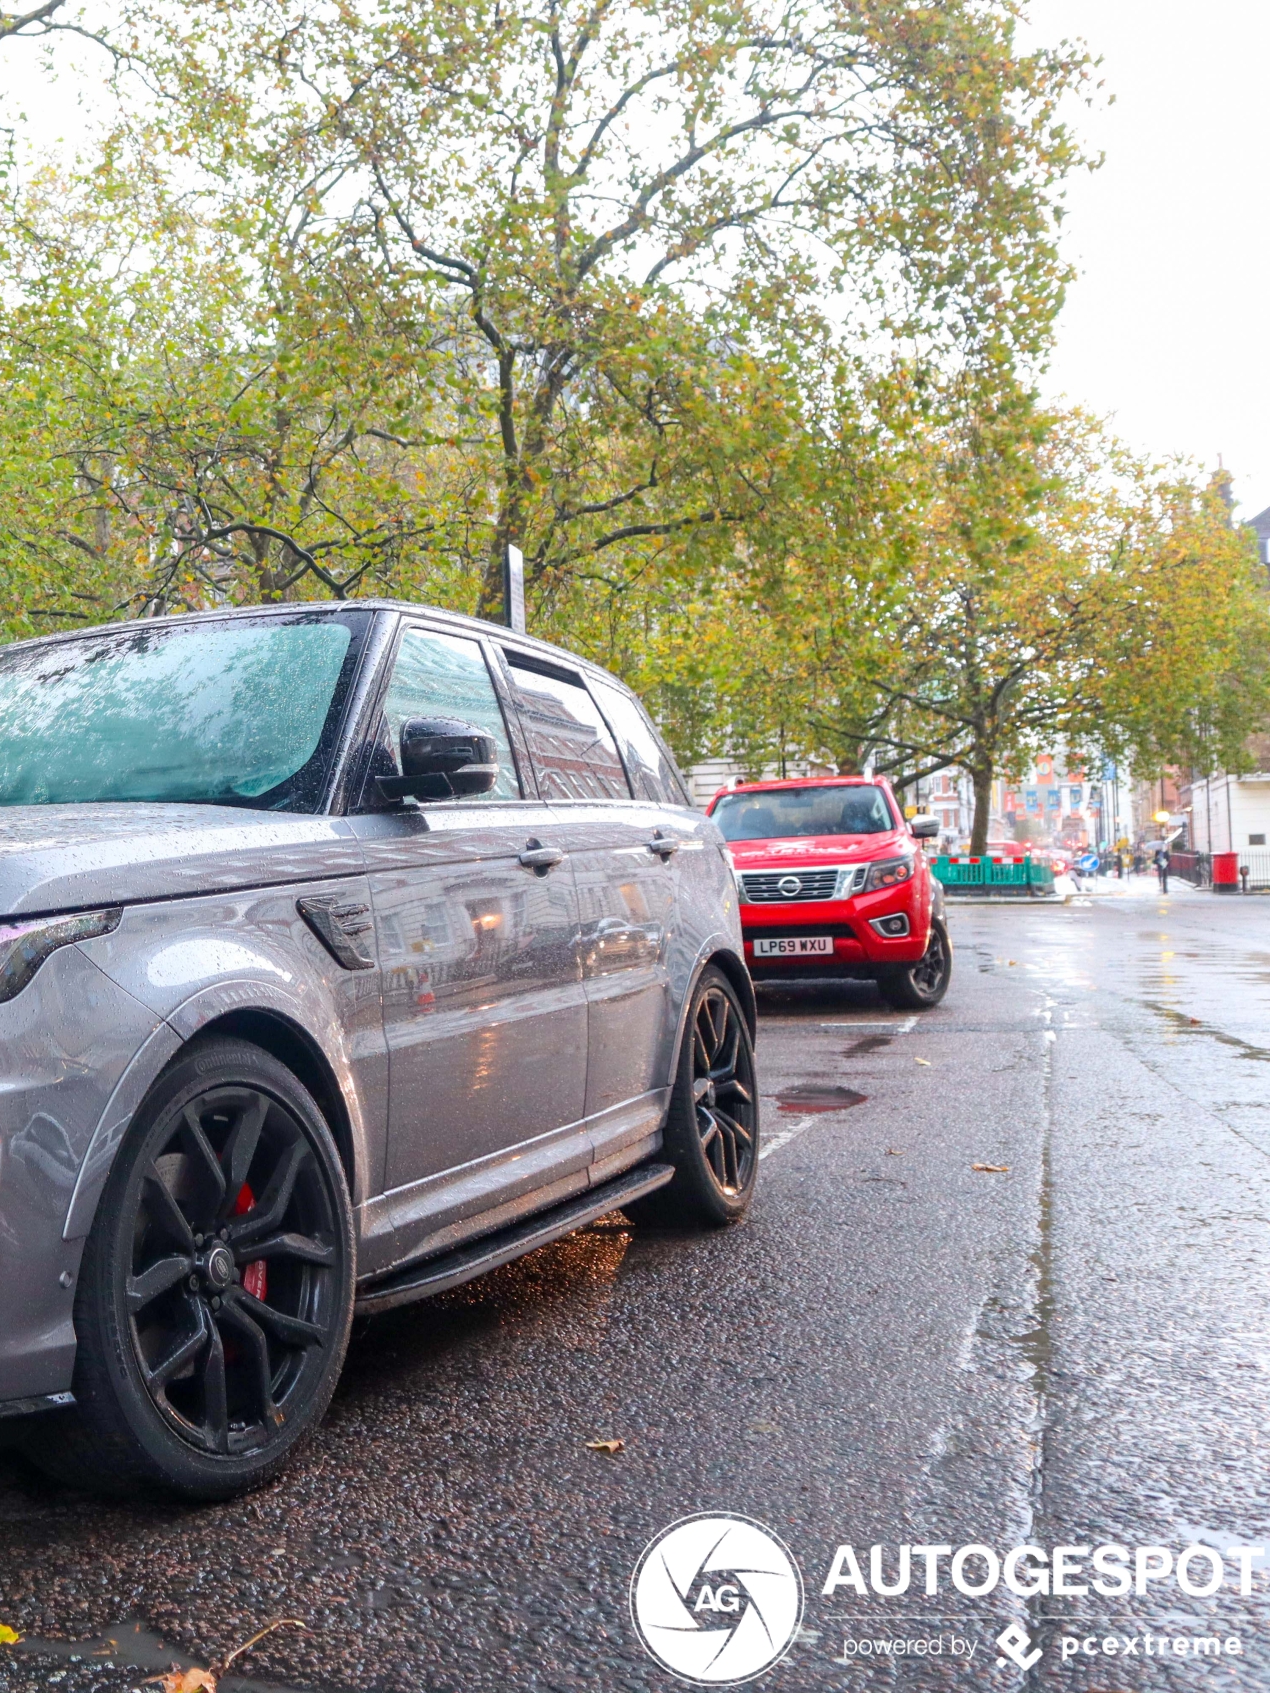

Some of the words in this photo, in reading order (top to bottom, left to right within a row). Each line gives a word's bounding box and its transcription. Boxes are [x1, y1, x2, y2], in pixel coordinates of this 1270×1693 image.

[760, 940, 796, 953] LP69
[800, 939, 826, 952] WXU
[256, 1260, 264, 1299] OVER
